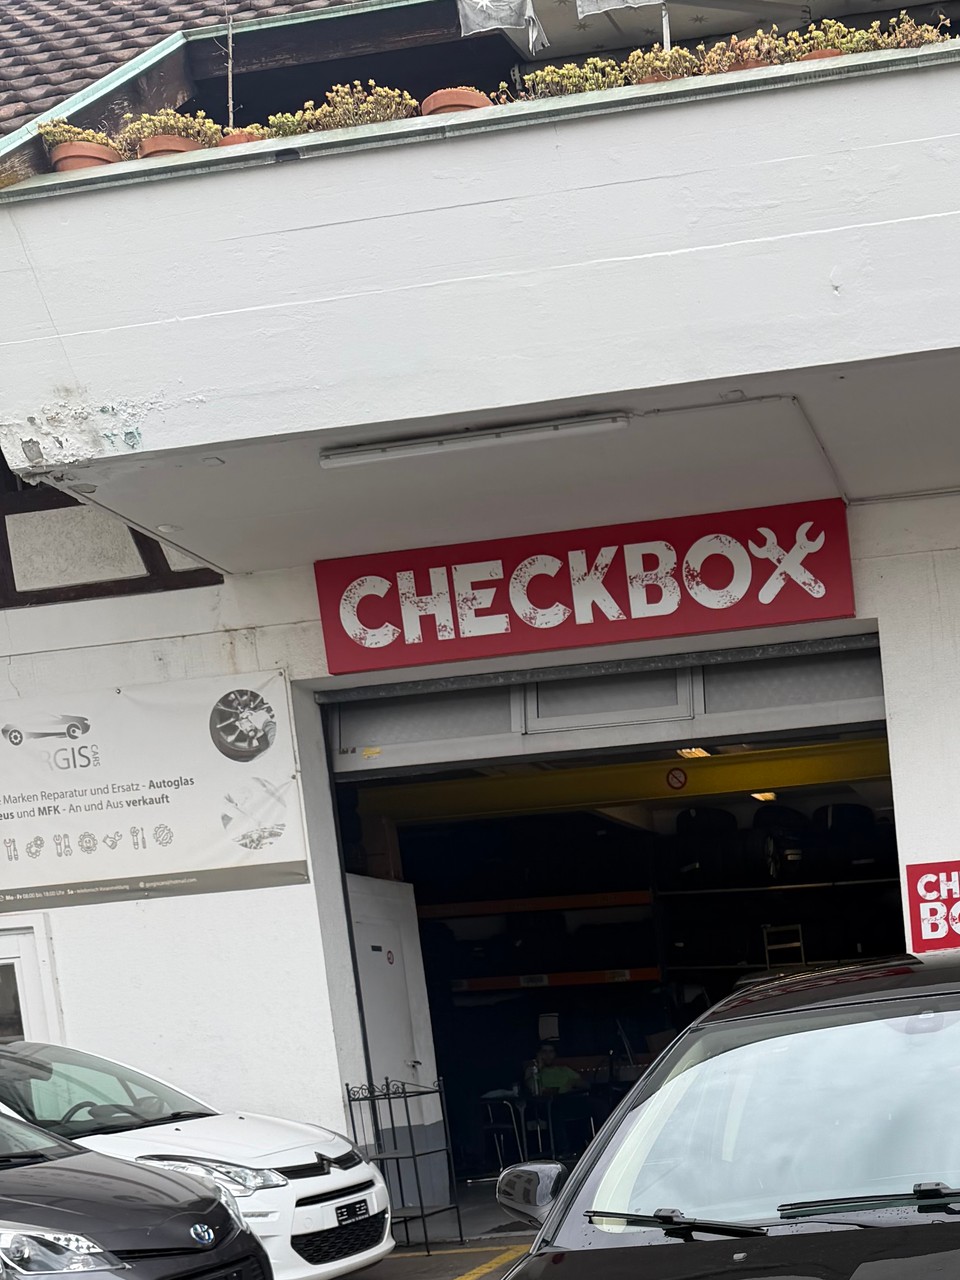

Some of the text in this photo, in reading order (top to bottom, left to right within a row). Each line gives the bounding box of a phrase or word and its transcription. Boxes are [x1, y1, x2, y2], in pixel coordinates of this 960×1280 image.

[339, 521, 826, 648] CHECKBOX
[90, 744, 101, 767] CARS
[3, 793, 39, 804] Marken
[40, 788, 88, 802] Reparatur
[90, 784, 110, 796] und
[111, 782, 140, 794] Ersatz
[148, 776, 195, 790] Autoglas
[16, 807, 36, 819] und
[37, 805, 61, 817] MFK
[68, 803, 82, 813] An
[84, 800, 104, 812] und
[105, 799, 124, 810] Aus
[125, 793, 170, 807] verkauft
